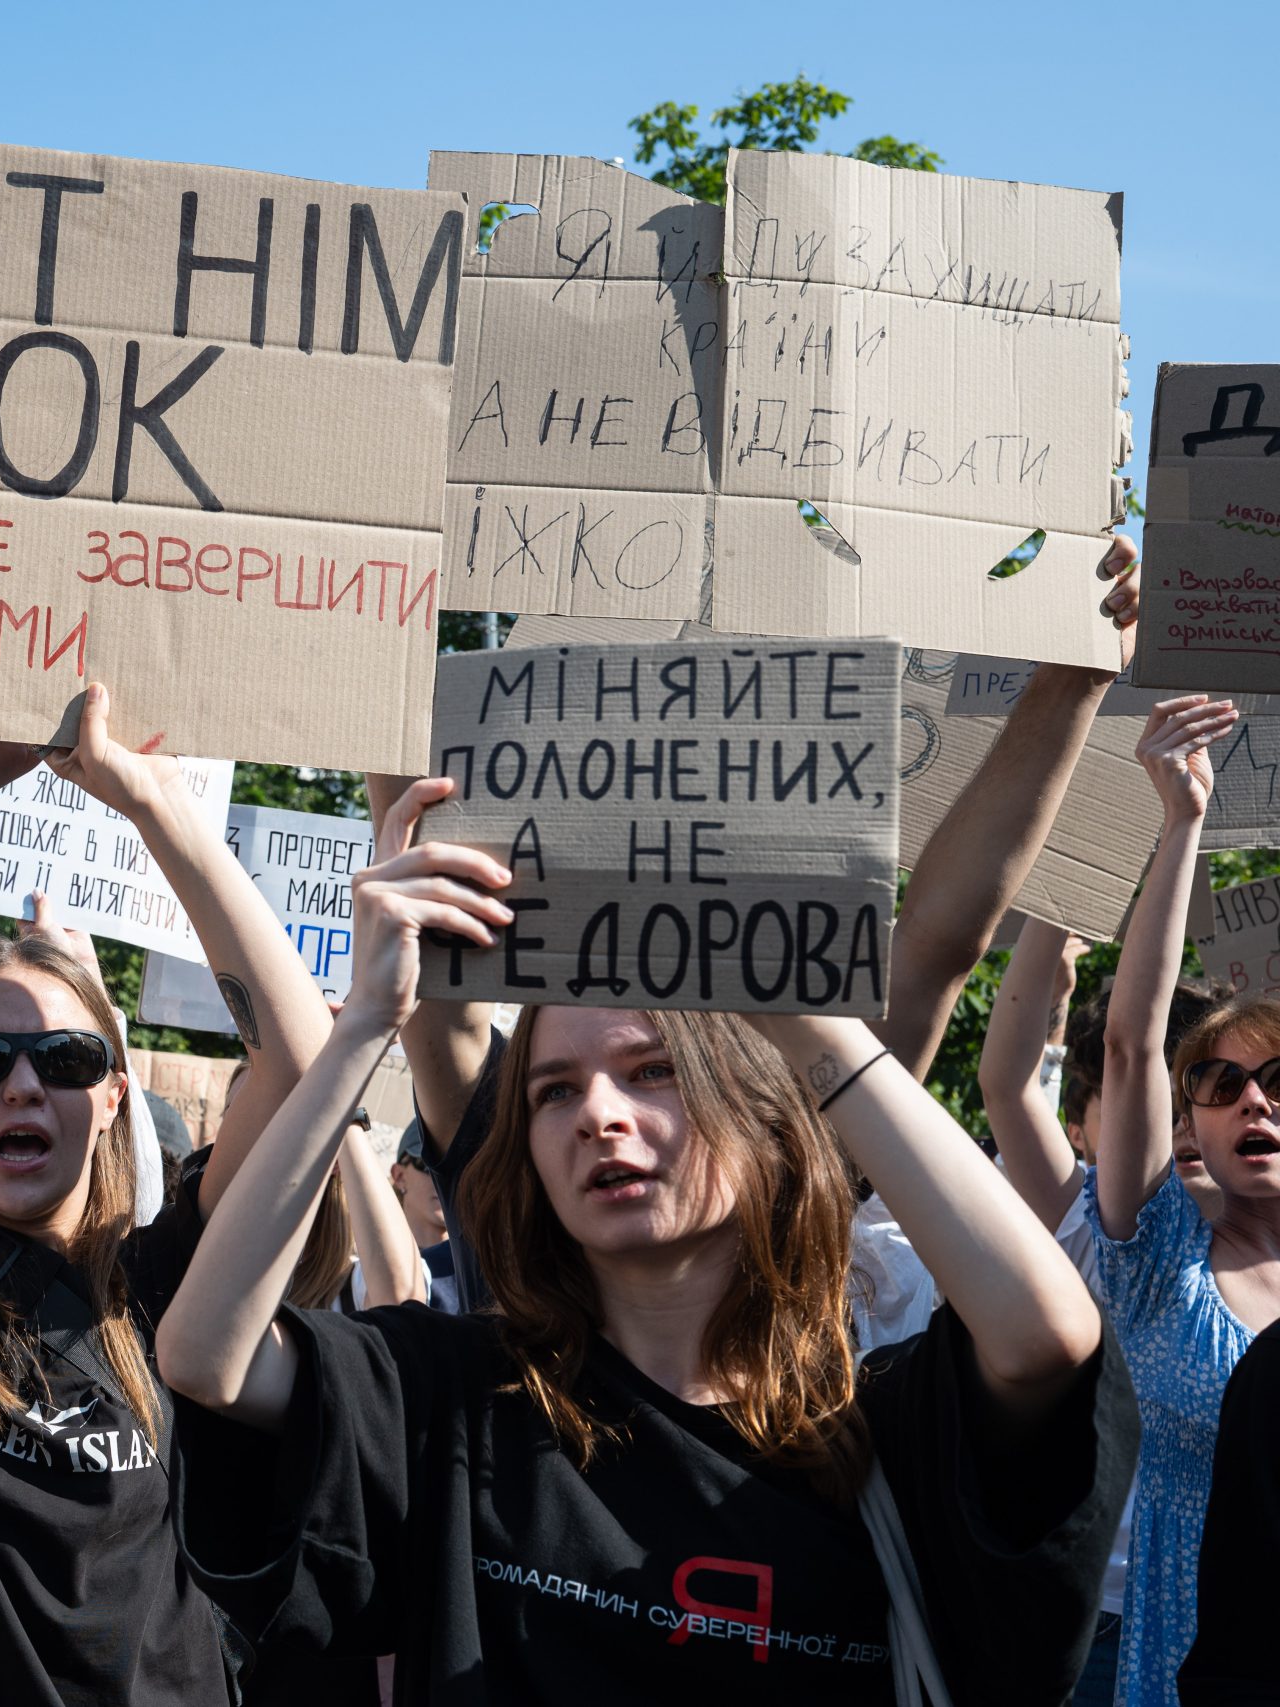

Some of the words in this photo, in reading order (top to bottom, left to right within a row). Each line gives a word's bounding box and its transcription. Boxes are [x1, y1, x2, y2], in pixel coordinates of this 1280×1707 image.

[173, 190, 462, 366] HIM
[552, 208, 613, 301] Я
[840, 225, 1102, 337] ЗАХИЩАТИ
[458, 380, 508, 452] А
[538, 389, 633, 449] НЕ
[1168, 618, 1280, 647] армійськ
[1174, 594, 1280, 619] адекватн
[479, 647, 865, 725] МІНЯЙТЕ
[440, 738, 885, 809] ПОЛОНЕНИХ,
[267, 830, 374, 876] ПРОФЕСІ
[509, 817, 546, 882] А
[627, 819, 728, 885] НЕ
[286, 876, 353, 919] МАЙБ
[65, 1428, 160, 1474] ISLAN
[648, 1605, 836, 1659] СУВЕРЕННОЇ
